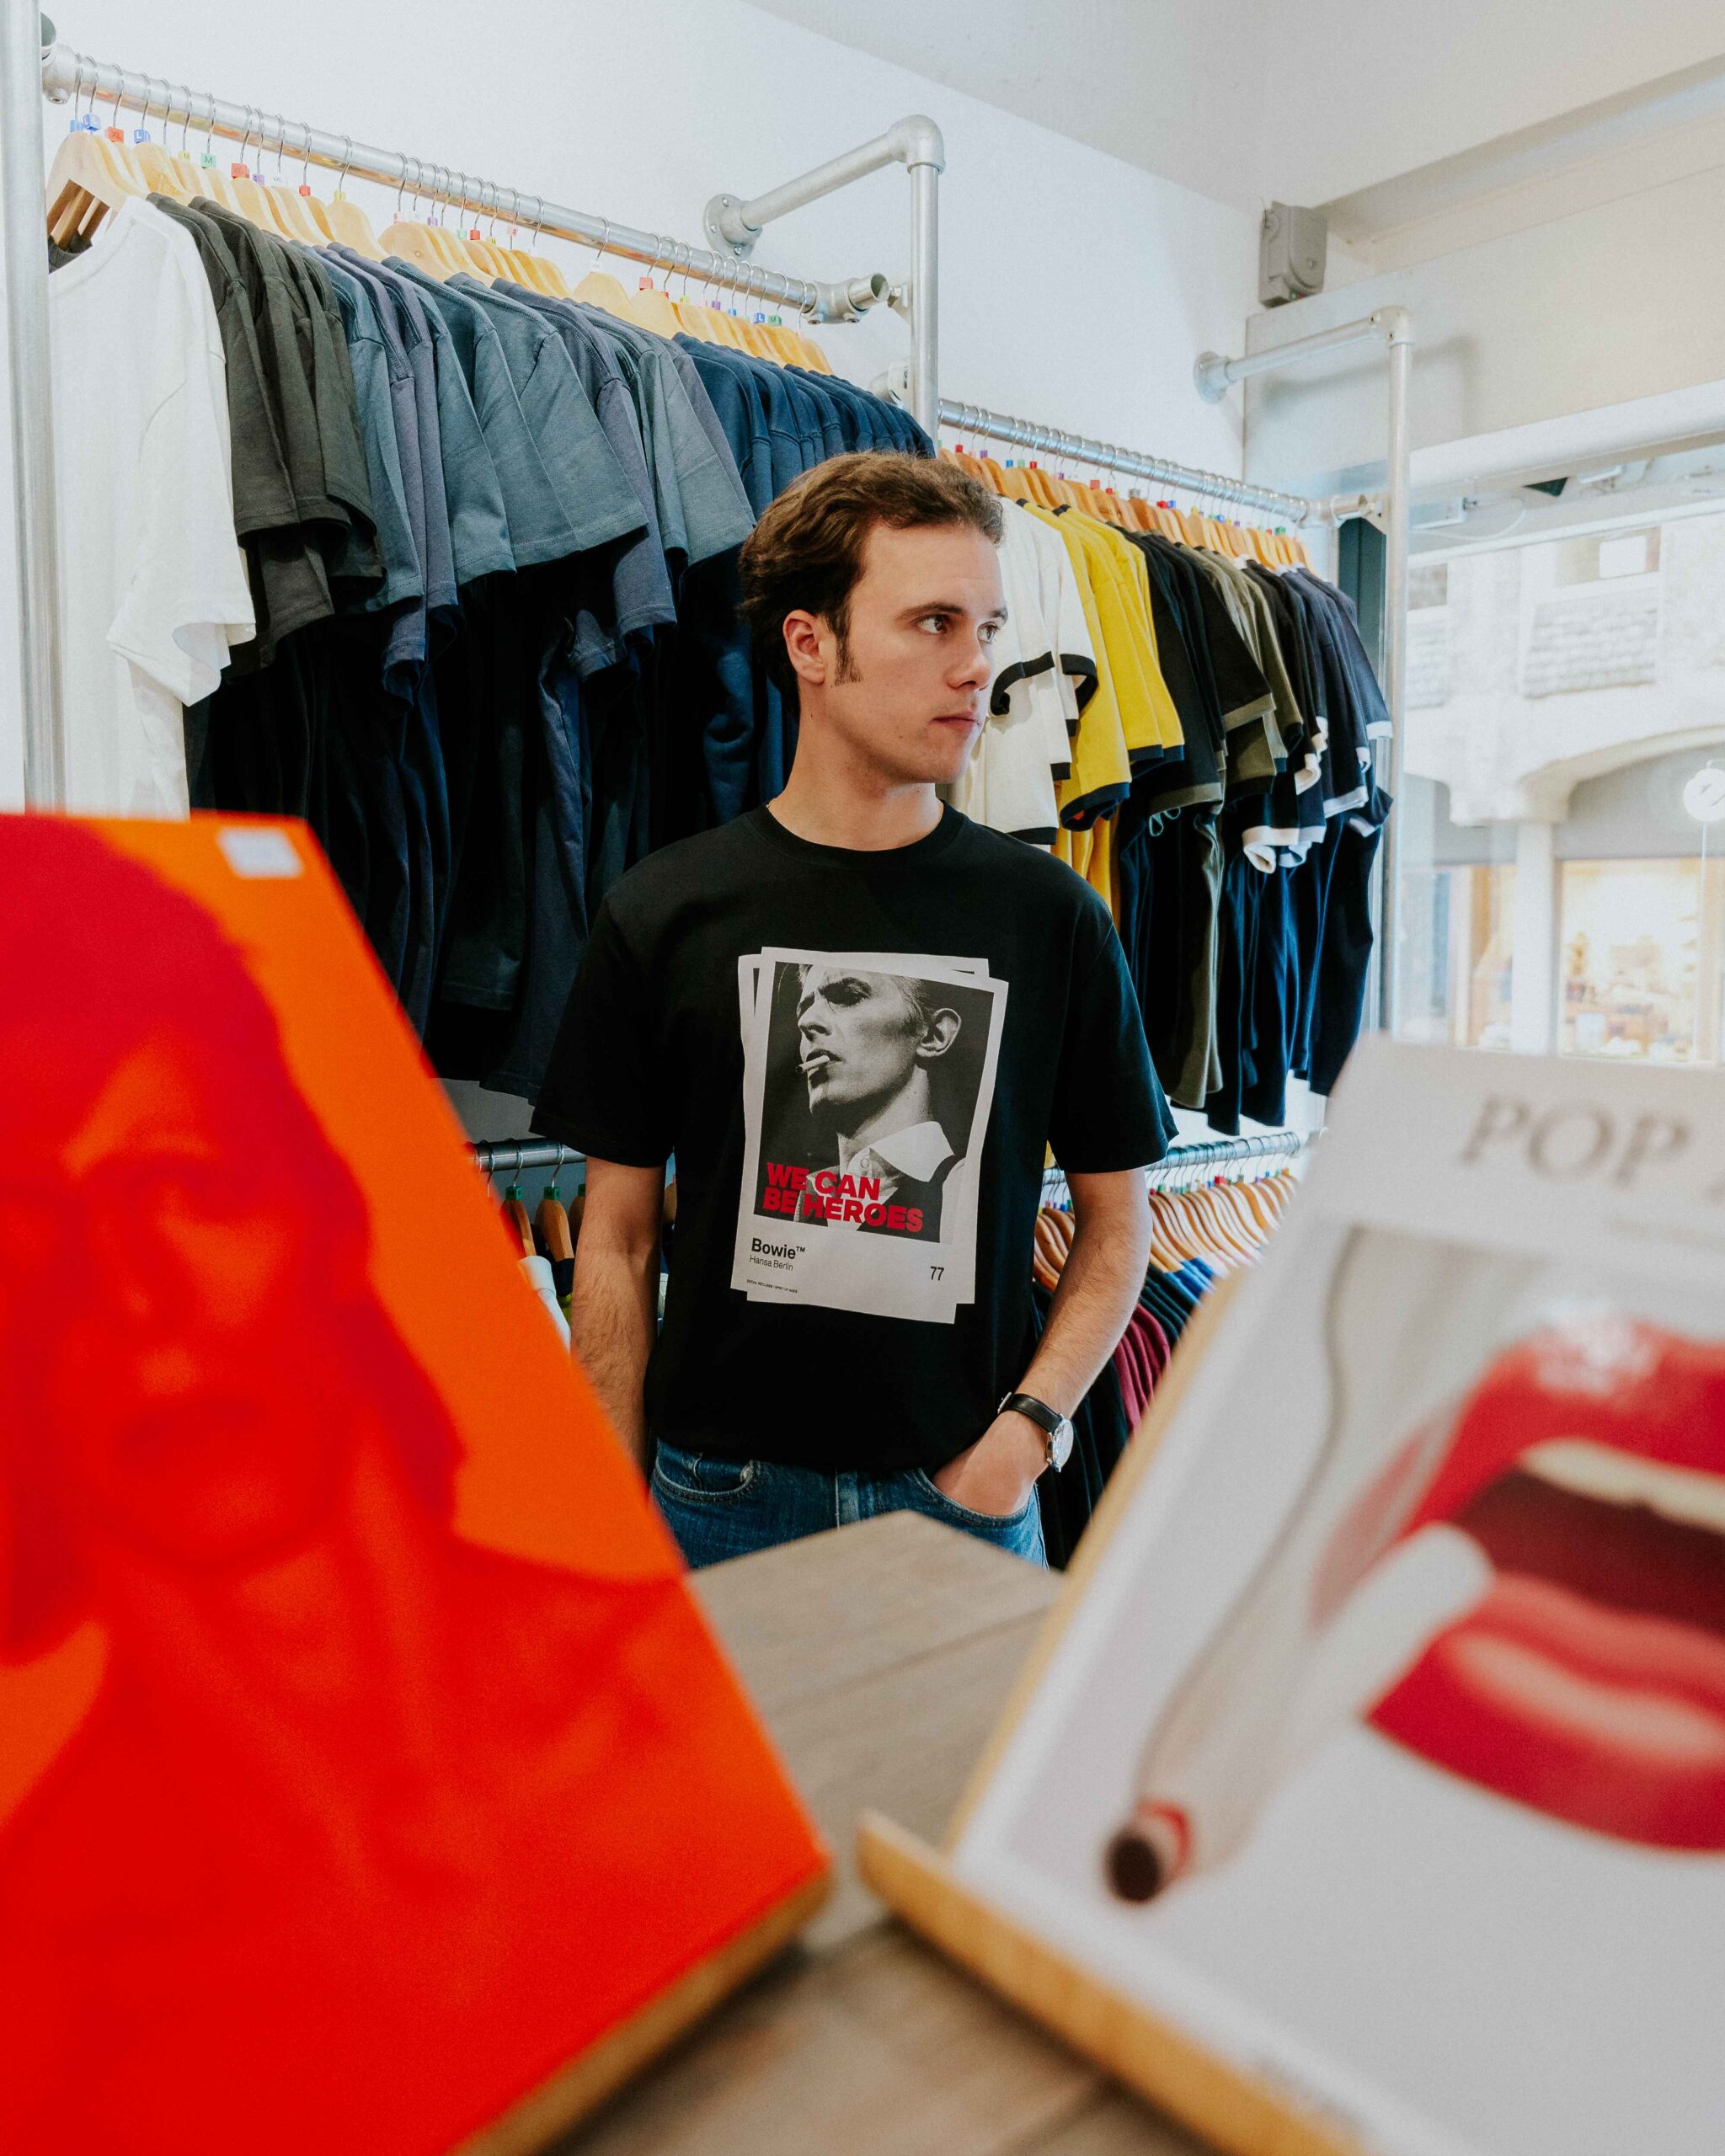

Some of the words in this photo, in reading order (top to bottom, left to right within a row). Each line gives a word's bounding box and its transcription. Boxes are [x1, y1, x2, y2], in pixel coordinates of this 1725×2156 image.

[1461, 1095, 1693, 1186] POP
[767, 1162, 809, 1190] WE
[814, 1171, 881, 1200] CAN
[762, 1187, 798, 1214] BE
[803, 1193, 923, 1232] HEROES
[750, 1255, 772, 1267] Hansa
[773, 1260, 793, 1271] Berlin
[931, 1267, 944, 1280] 77
